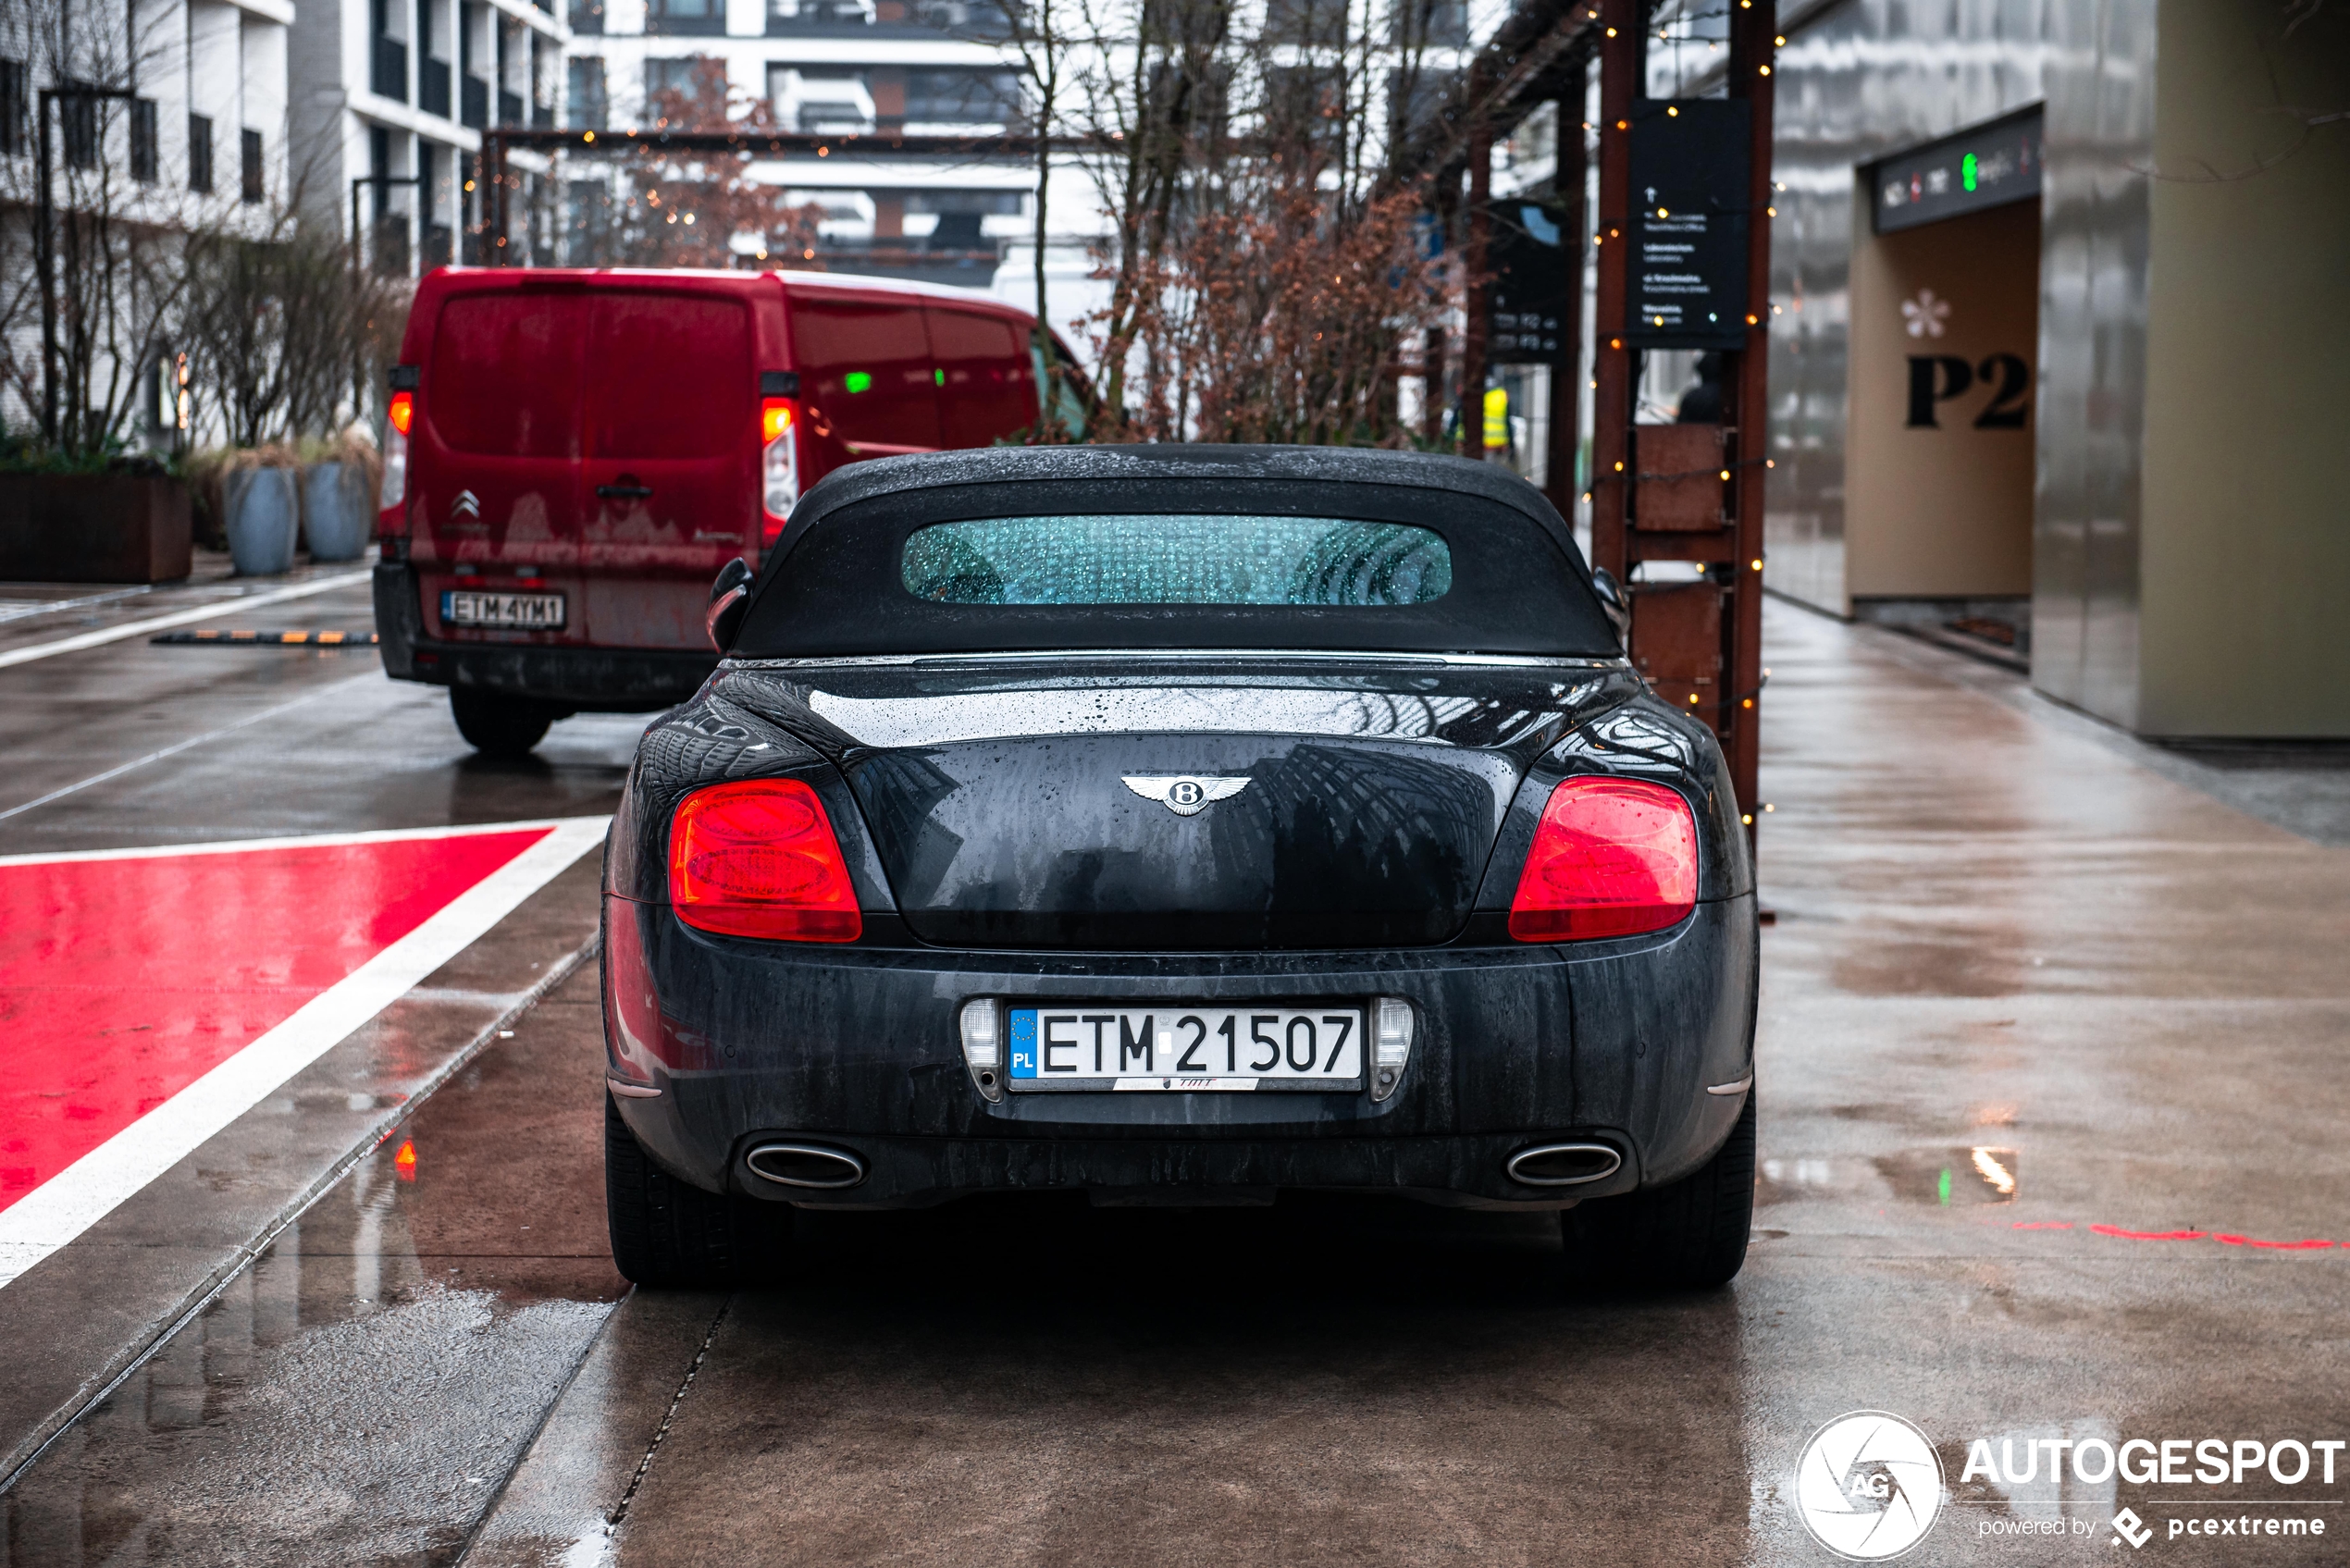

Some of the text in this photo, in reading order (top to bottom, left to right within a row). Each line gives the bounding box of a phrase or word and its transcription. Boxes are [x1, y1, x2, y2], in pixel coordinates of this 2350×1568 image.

[1907, 352, 2028, 429] P2
[456, 597, 499, 620] ETM
[1174, 784, 1198, 804] B
[1044, 1015, 1354, 1072] ETM 21507
[1013, 1053, 1033, 1068] PL
